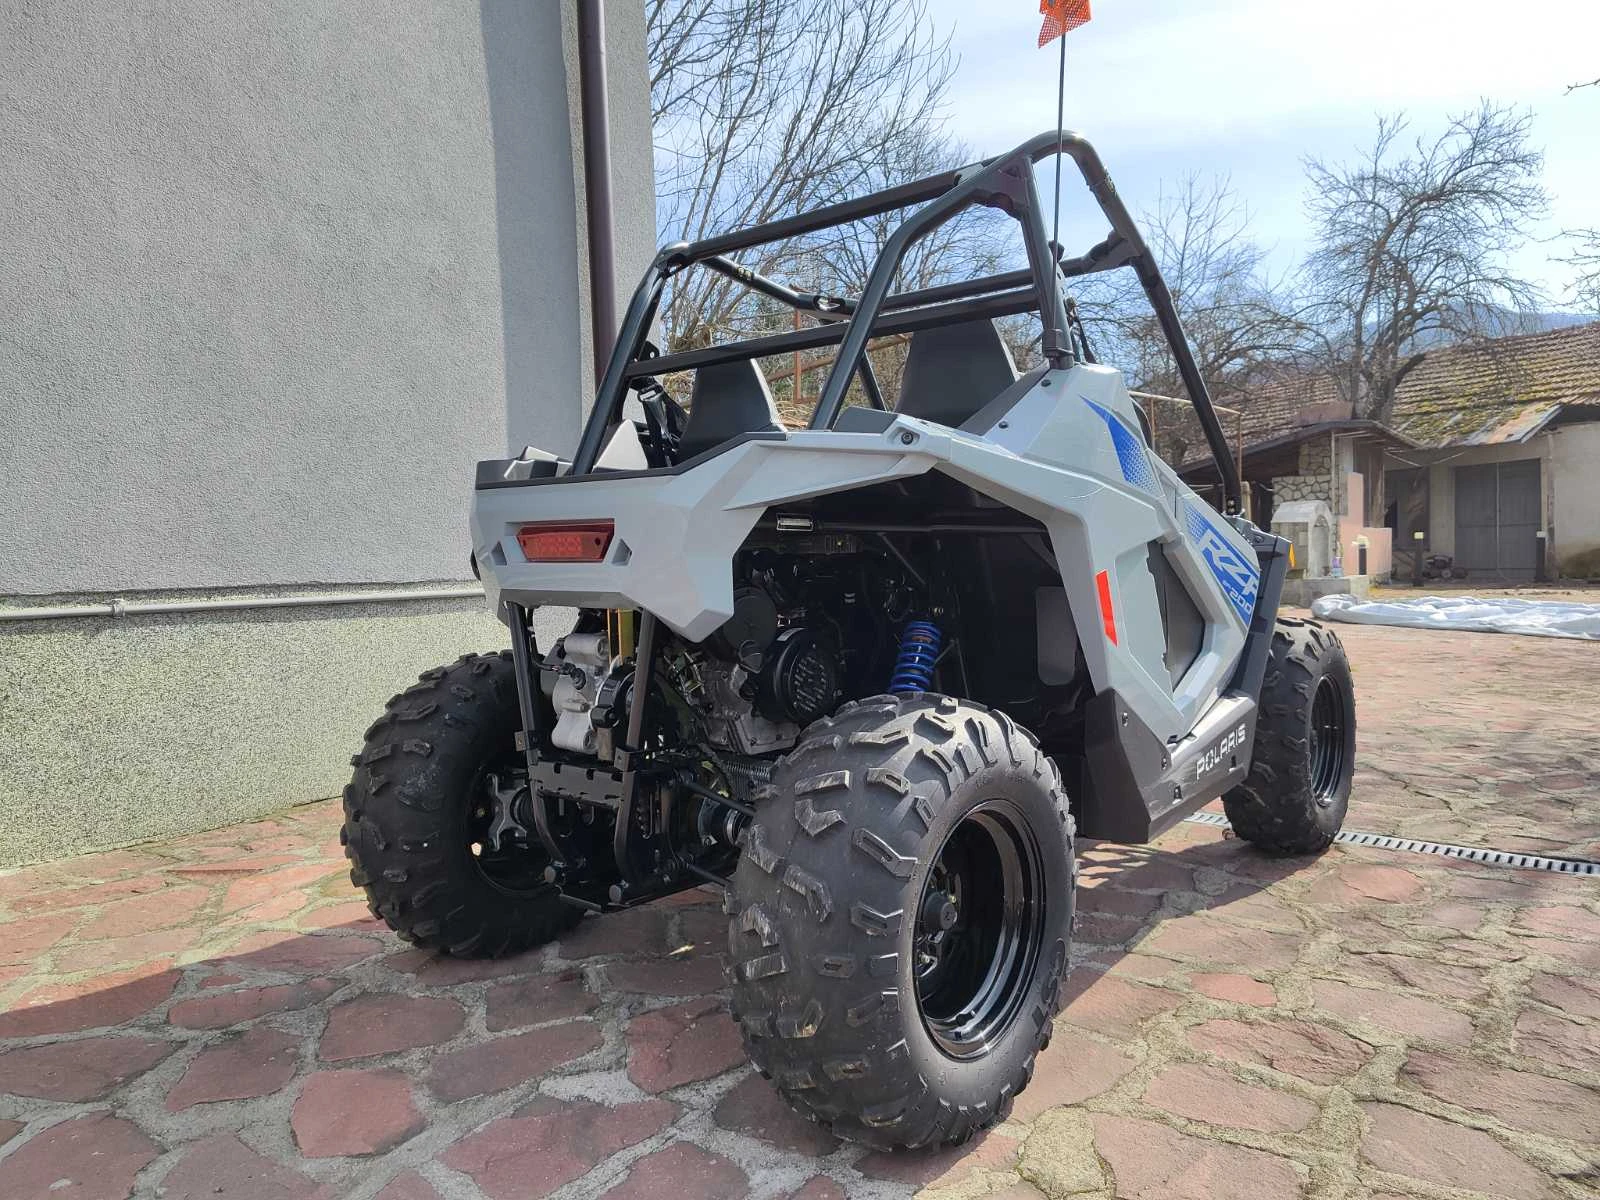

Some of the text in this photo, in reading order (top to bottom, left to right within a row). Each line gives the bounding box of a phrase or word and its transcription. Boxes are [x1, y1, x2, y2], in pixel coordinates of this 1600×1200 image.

[1199, 529, 1258, 594] RZR
[1229, 587, 1253, 614] 200
[1196, 722, 1246, 781] POLARIS
